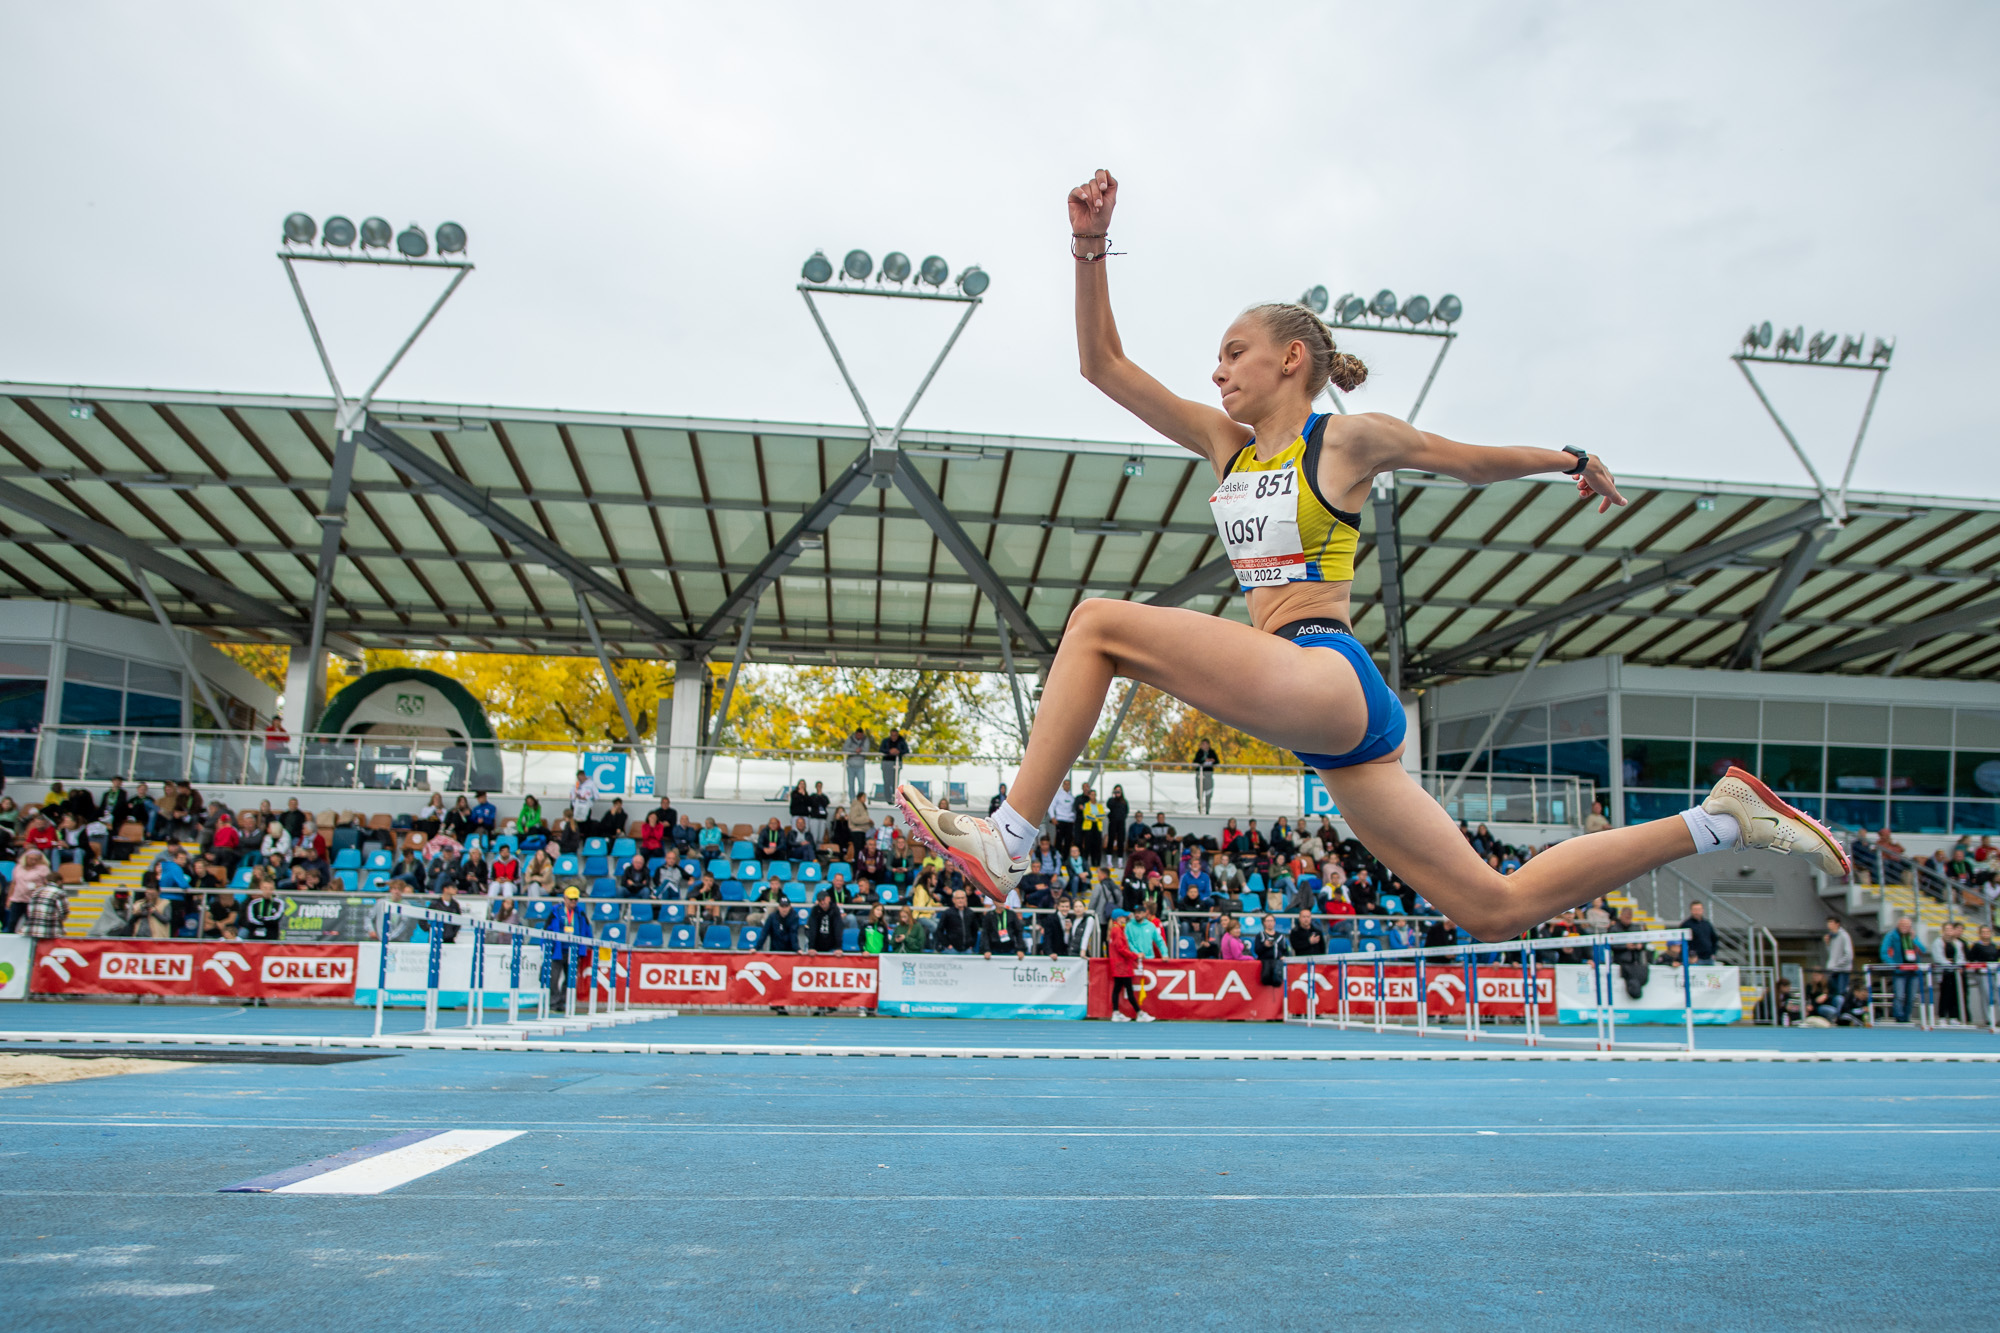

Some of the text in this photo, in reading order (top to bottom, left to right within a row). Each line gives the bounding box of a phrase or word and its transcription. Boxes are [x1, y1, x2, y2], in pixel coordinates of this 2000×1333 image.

[1255, 470, 1295, 499] 851
[1224, 515, 1269, 545] LOSY
[1254, 568, 1282, 582] 2022
[593, 763, 617, 791] C
[636, 778, 652, 787] WC
[1312, 785, 1335, 812] D
[298, 904, 342, 918] runner
[106, 957, 185, 976] ORLEN
[268, 961, 347, 979] ORLEN
[646, 968, 720, 986] ORLEN
[797, 970, 871, 989] ORLEN
[1124, 969, 1252, 1001] PZLA
